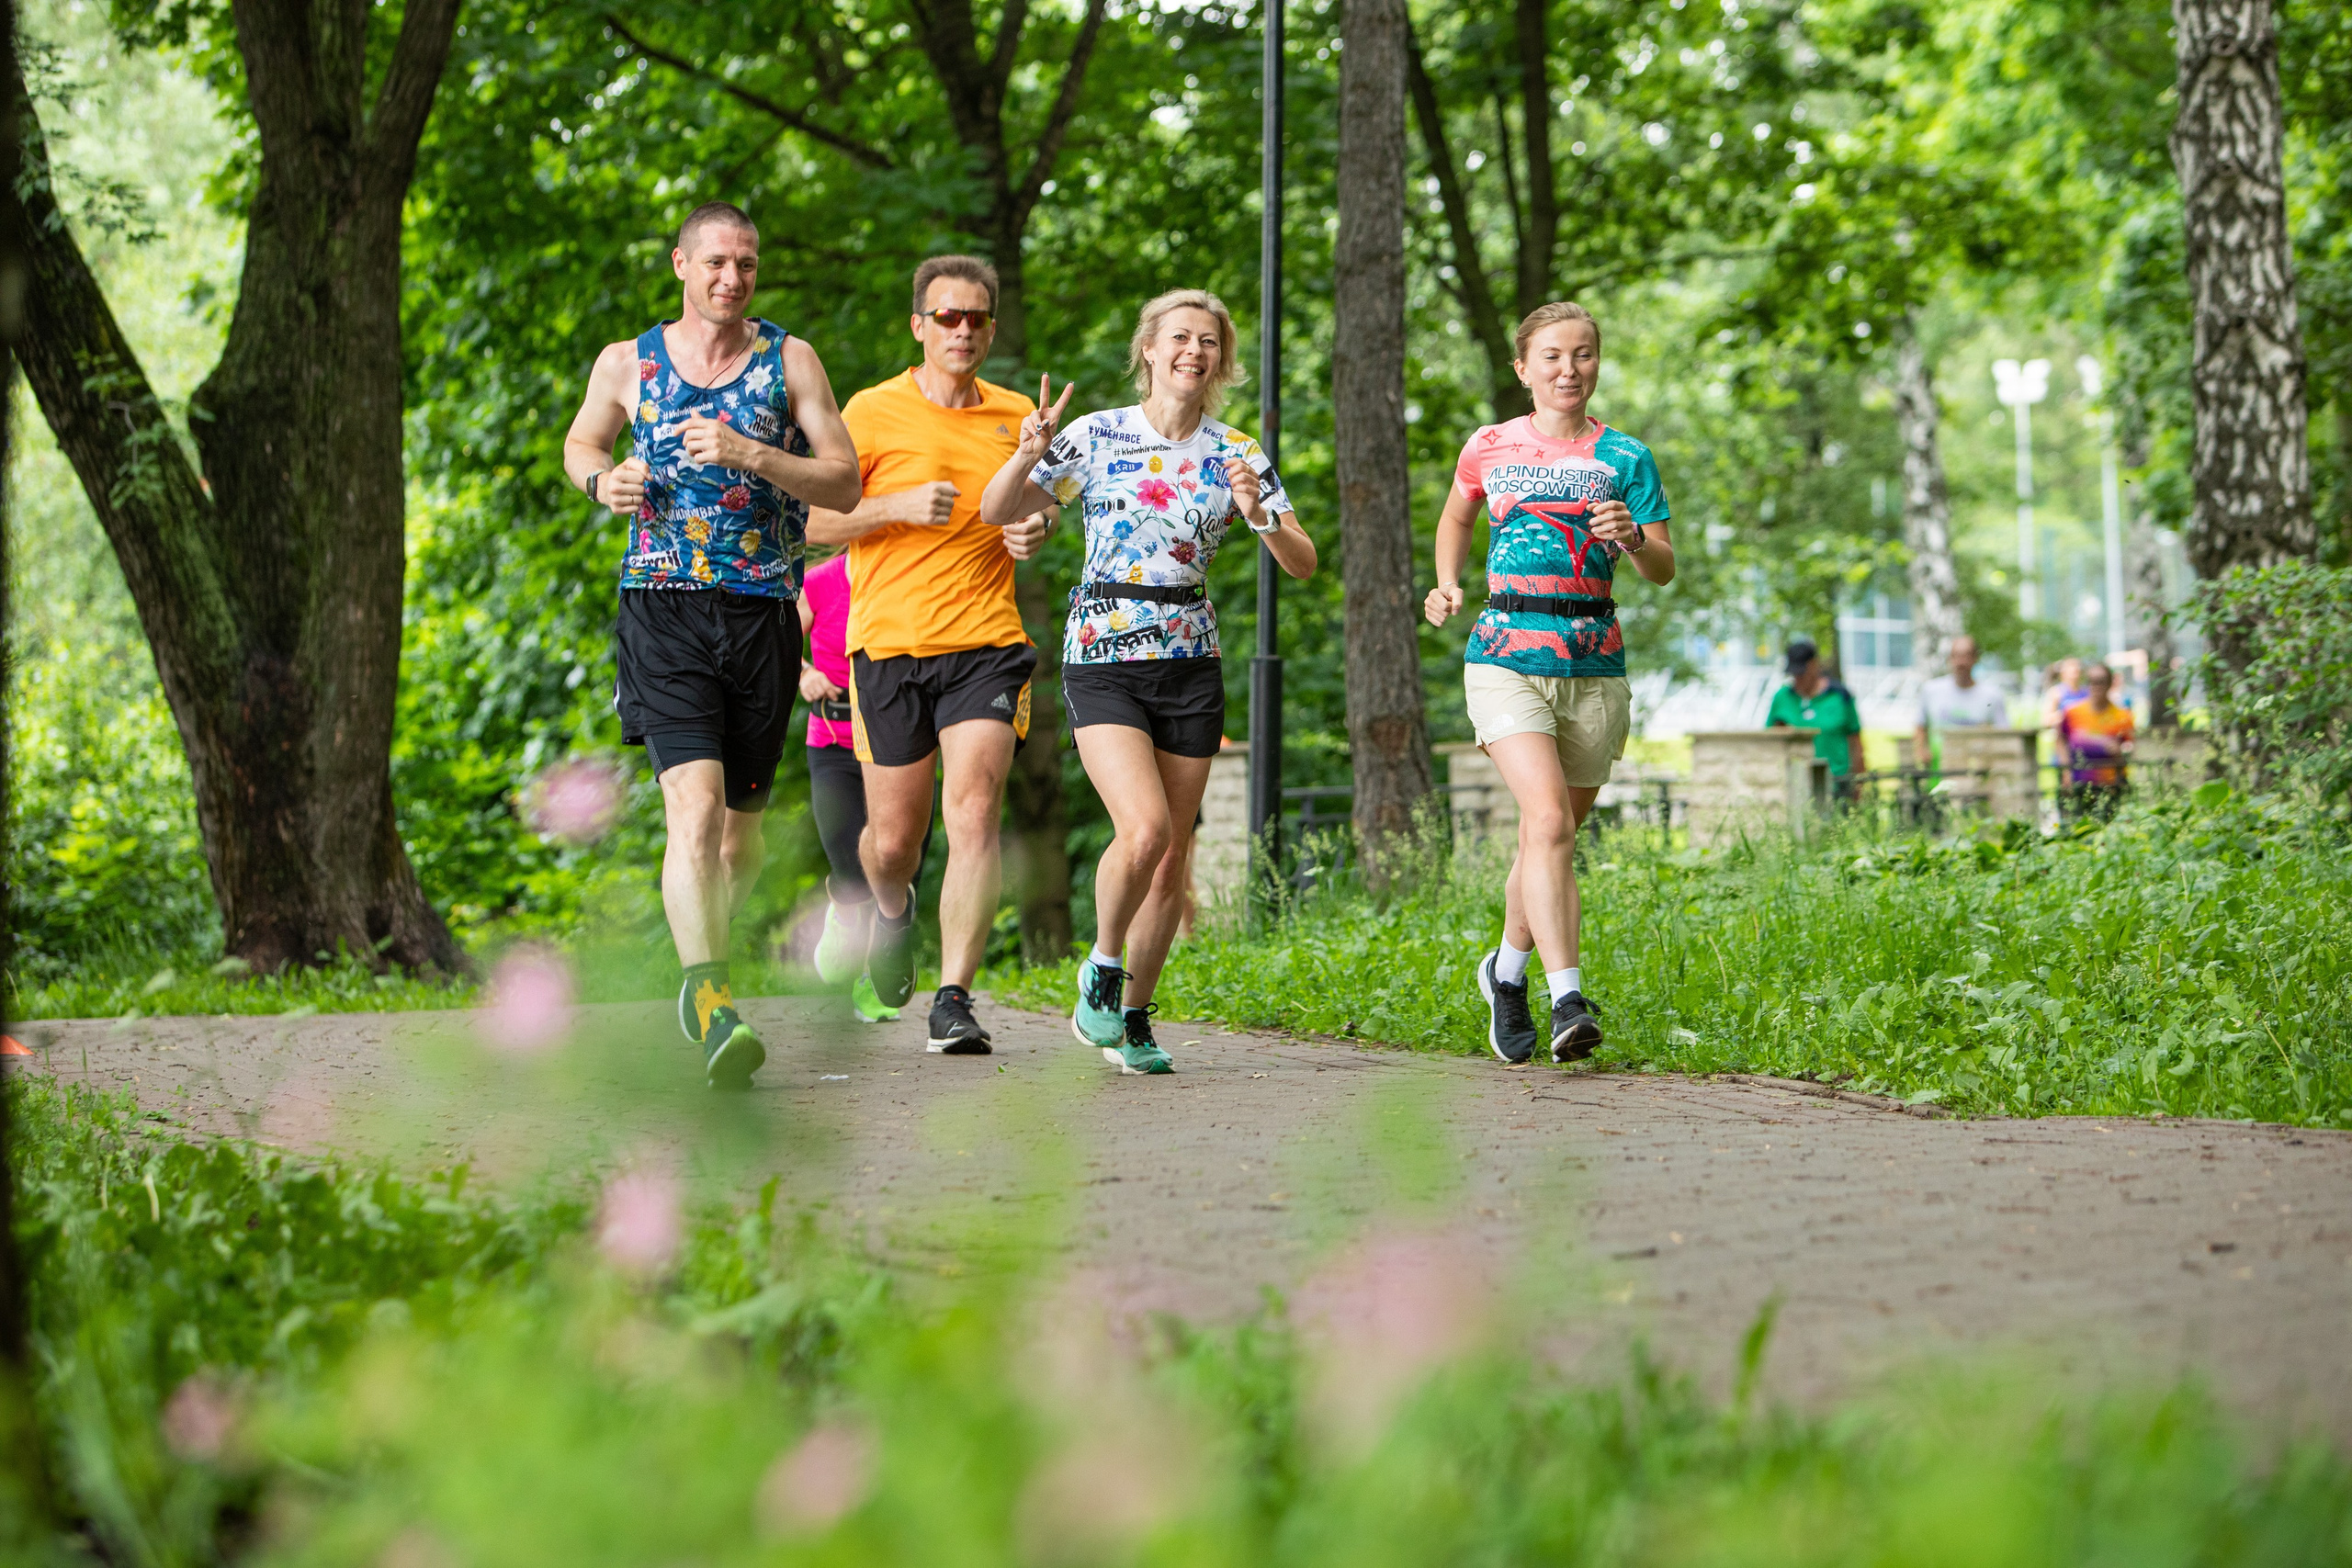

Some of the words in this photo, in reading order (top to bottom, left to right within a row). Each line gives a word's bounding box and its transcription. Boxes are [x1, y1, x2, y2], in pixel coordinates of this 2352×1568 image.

[1088, 425, 1141, 444] #УМЕНЯВСЕ
[1034, 465, 1053, 480] ЗНАТЬ
[1114, 463, 1136, 472] KRB
[1488, 479, 1566, 496] MOSCOW
